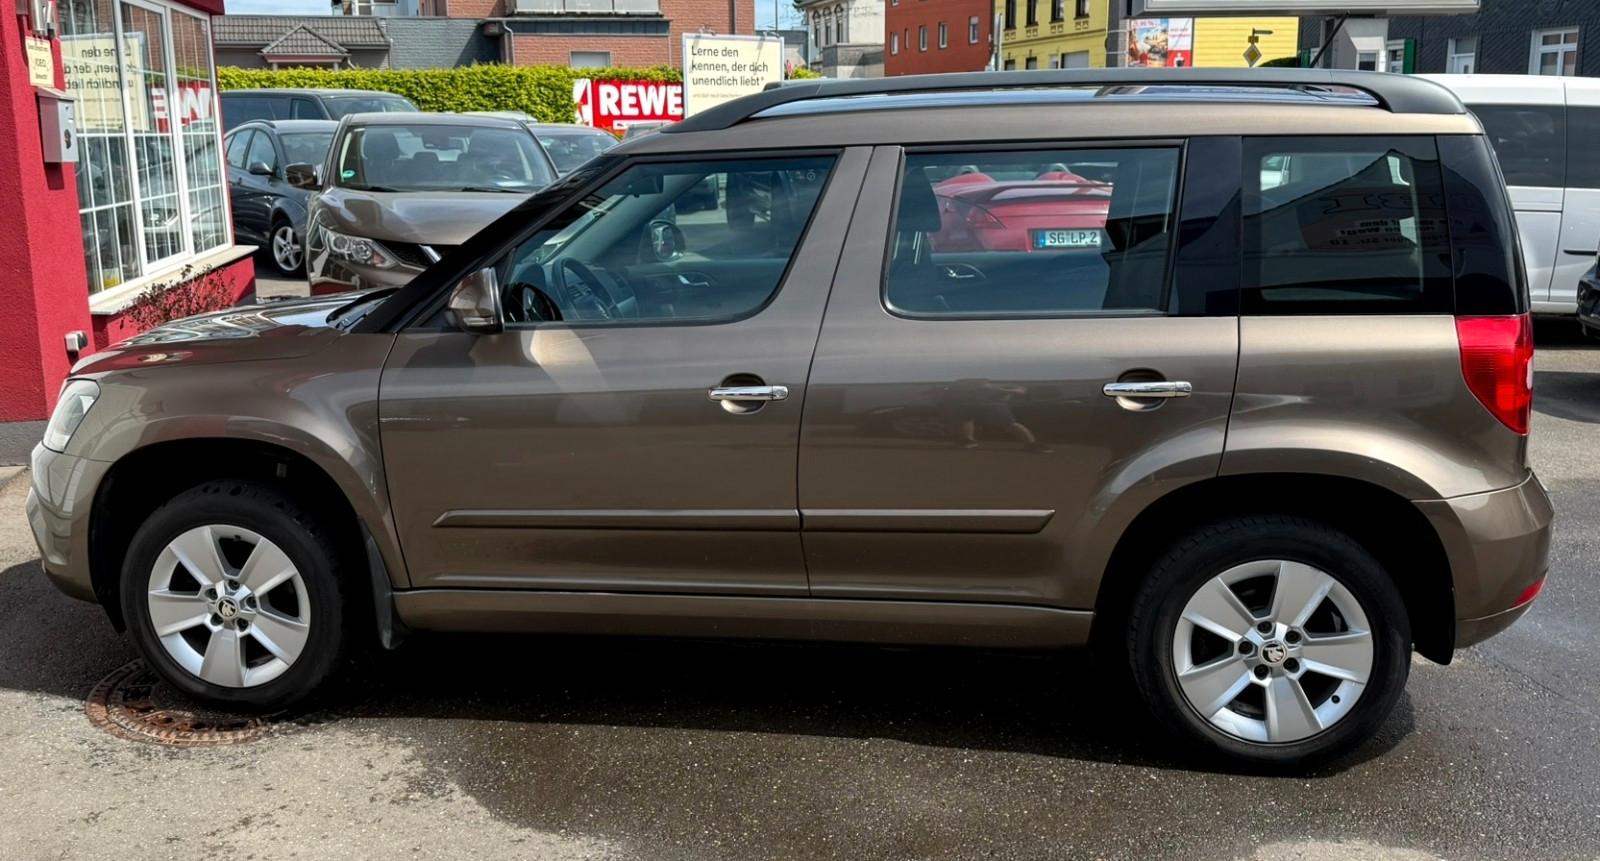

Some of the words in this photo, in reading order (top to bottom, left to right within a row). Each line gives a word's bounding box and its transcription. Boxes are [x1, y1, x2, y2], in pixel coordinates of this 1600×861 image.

[691, 45, 719, 57] Lerne
[721, 46, 739, 57] den
[691, 60, 730, 73] kennen,
[731, 61, 747, 72] der
[749, 61, 768, 72] dich
[692, 75, 738, 86] unendlich
[600, 84, 682, 116] REWE
[1049, 232, 1065, 244] SG
[1071, 232, 1086, 244] LP
[1090, 231, 1097, 243] 2
